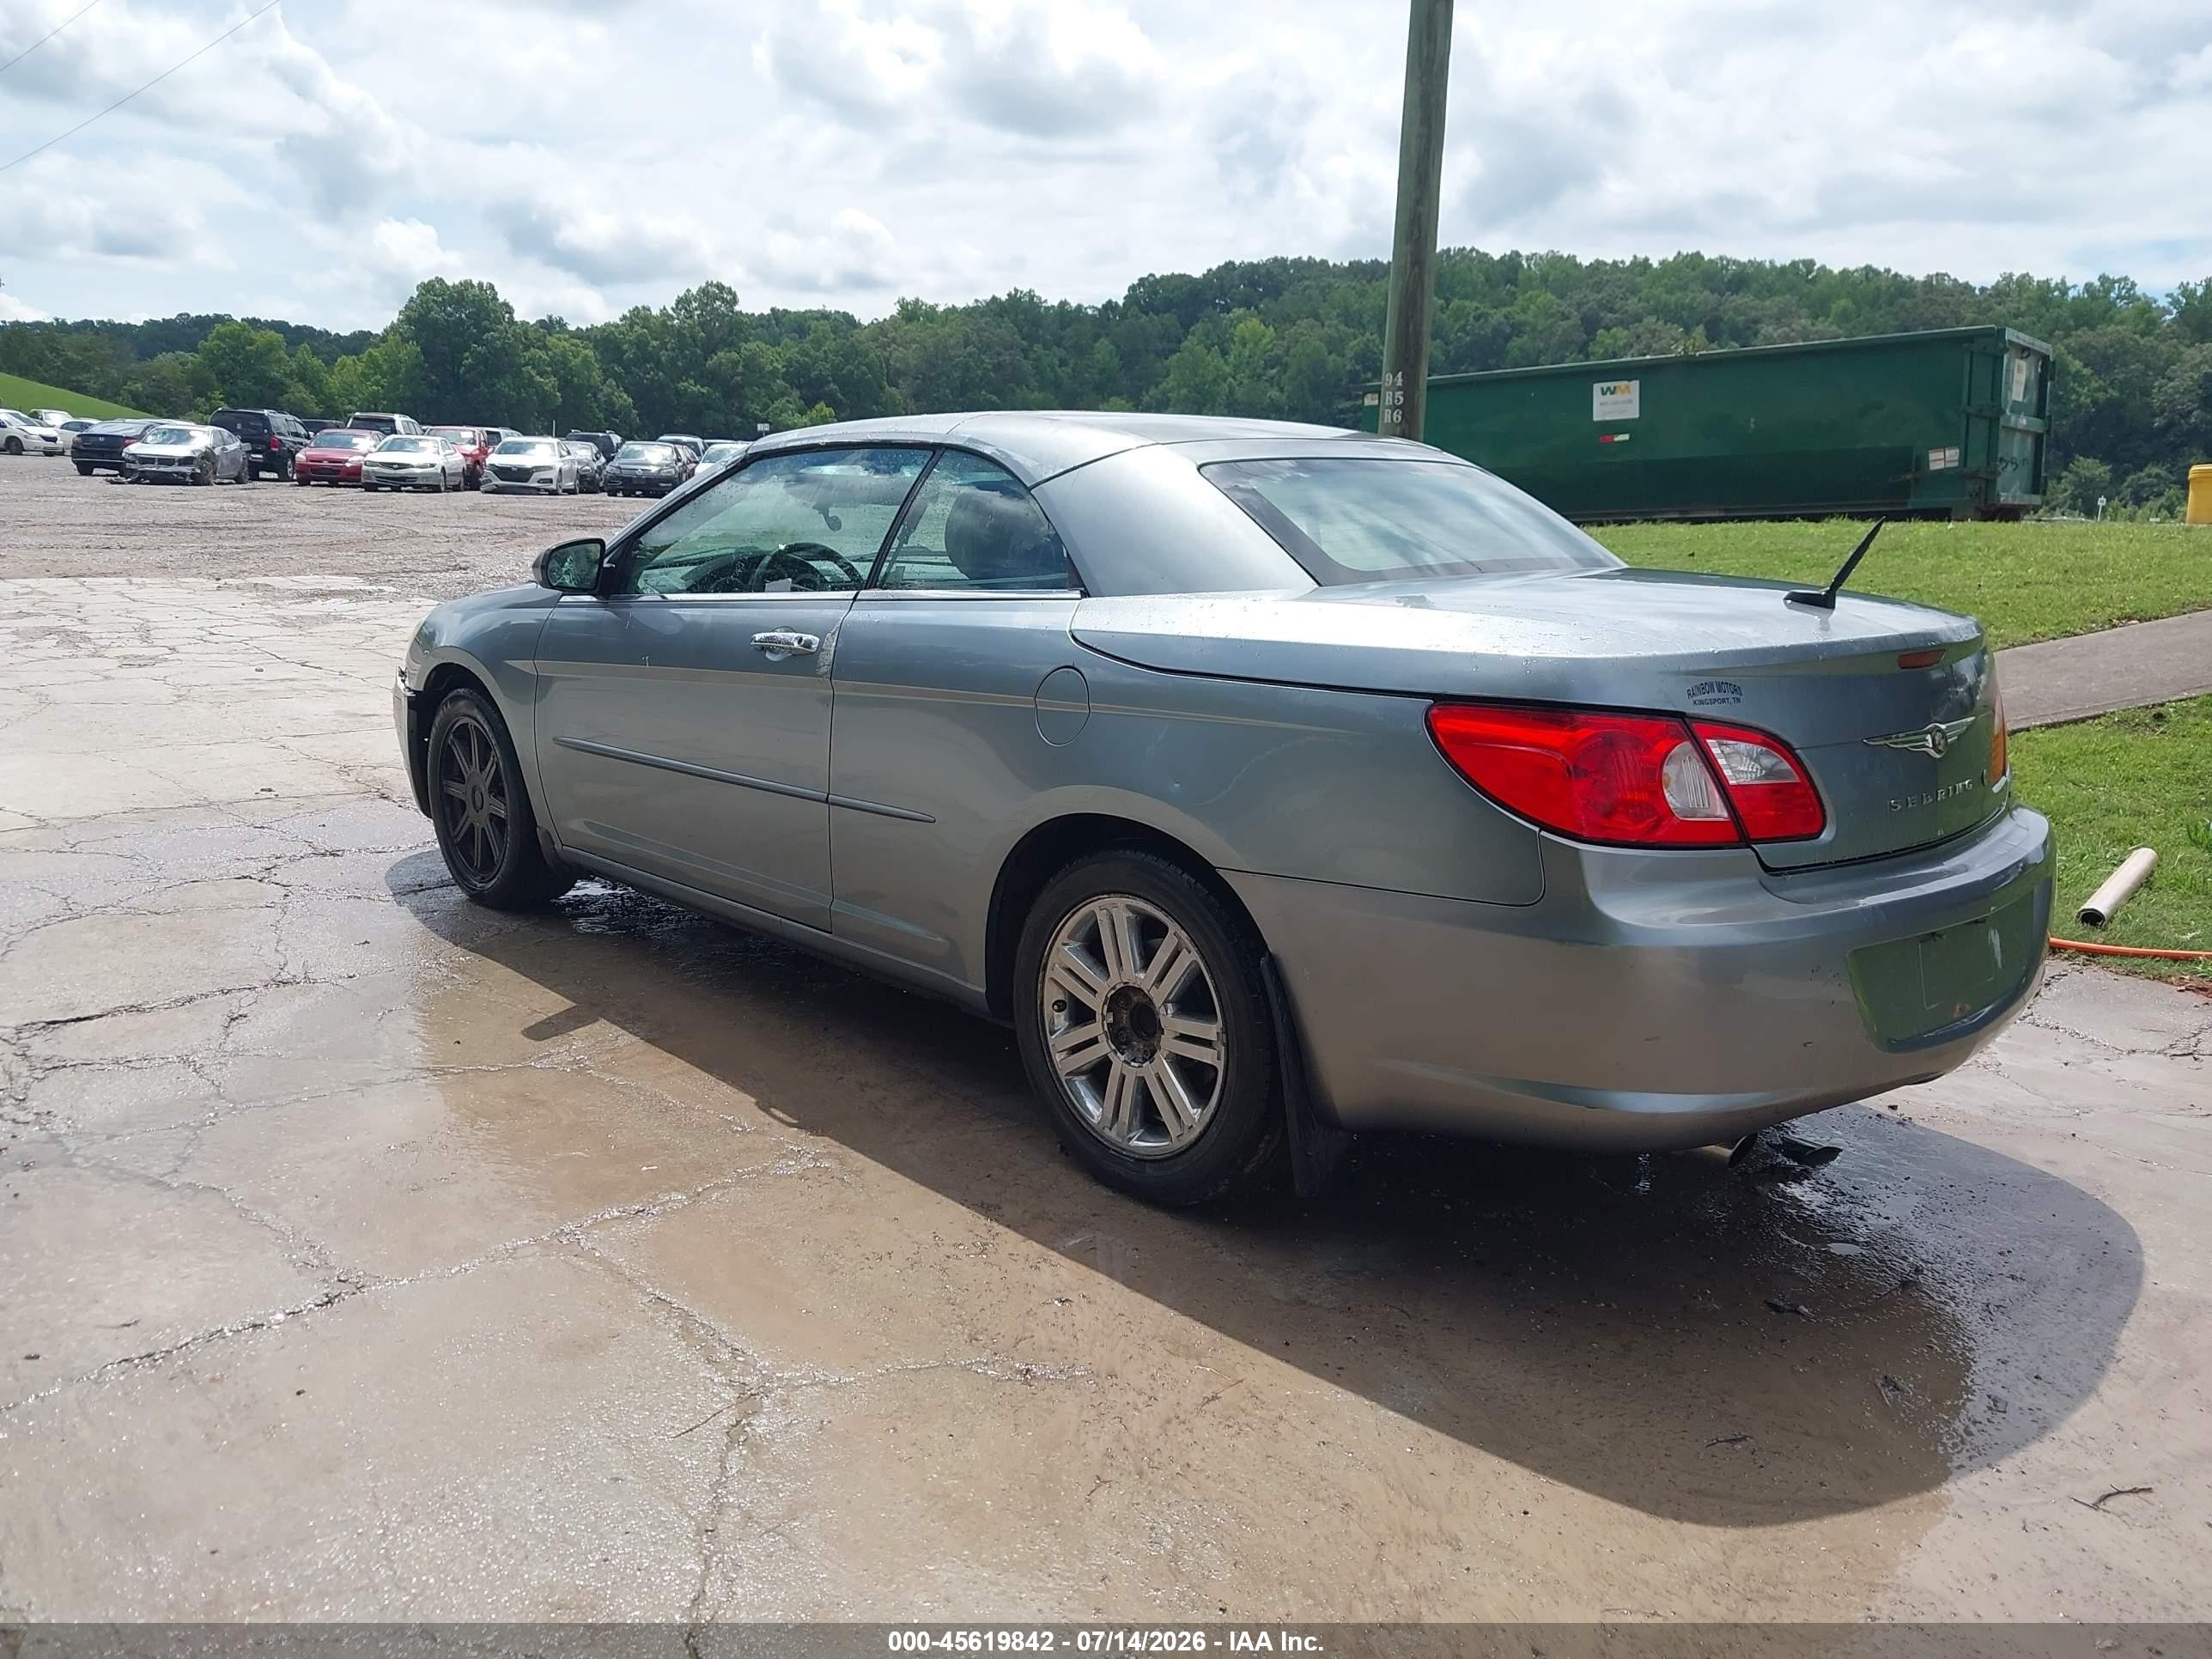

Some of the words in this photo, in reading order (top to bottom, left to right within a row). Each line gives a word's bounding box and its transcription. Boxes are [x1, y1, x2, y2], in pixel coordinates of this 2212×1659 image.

[1601, 385, 1631, 396] WM
[1385, 391, 1404, 405] R5
[1384, 409, 1402, 423] R6
[1686, 681, 1715, 699] RAINBOW
[1715, 680, 1742, 696] MOTORS
[1889, 779, 1973, 811] SEBRING
